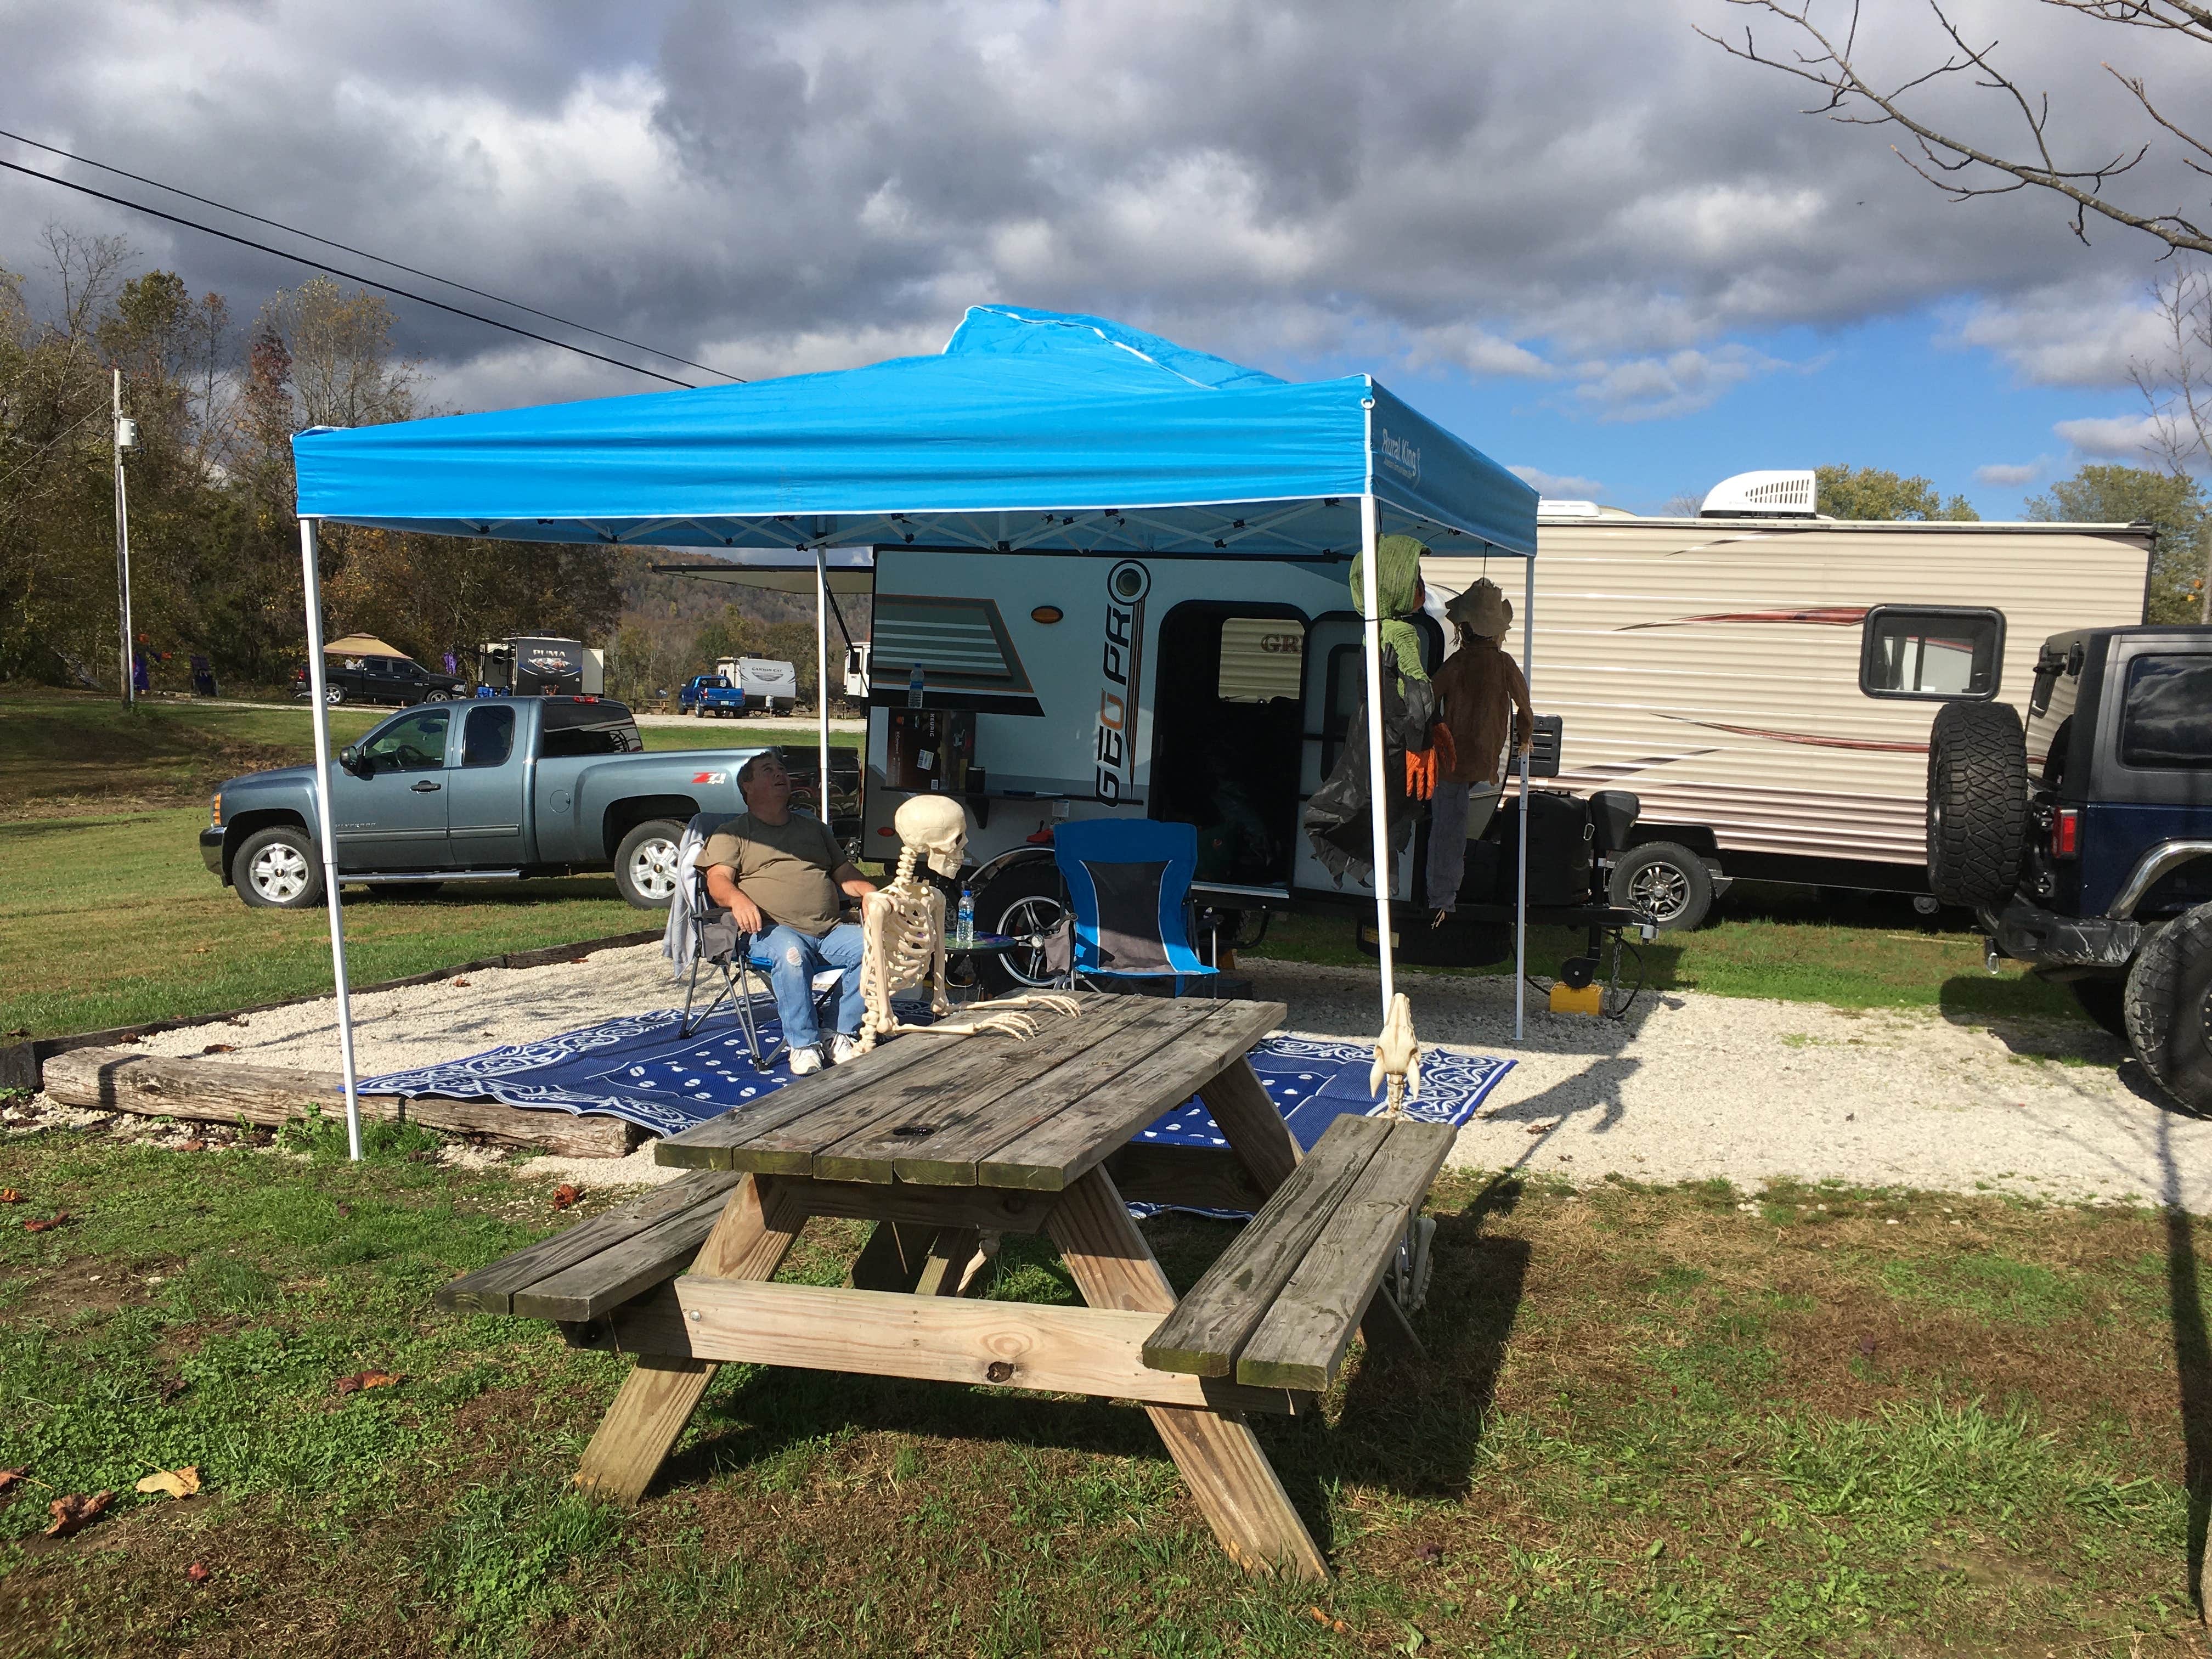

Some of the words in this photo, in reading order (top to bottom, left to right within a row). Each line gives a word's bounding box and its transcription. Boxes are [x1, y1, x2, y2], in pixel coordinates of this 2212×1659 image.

[1381, 427, 1401, 461] Rural
[533, 649, 566, 657] PUMA
[1096, 688, 1125, 808] GEO
[691, 772, 726, 783] Z71
